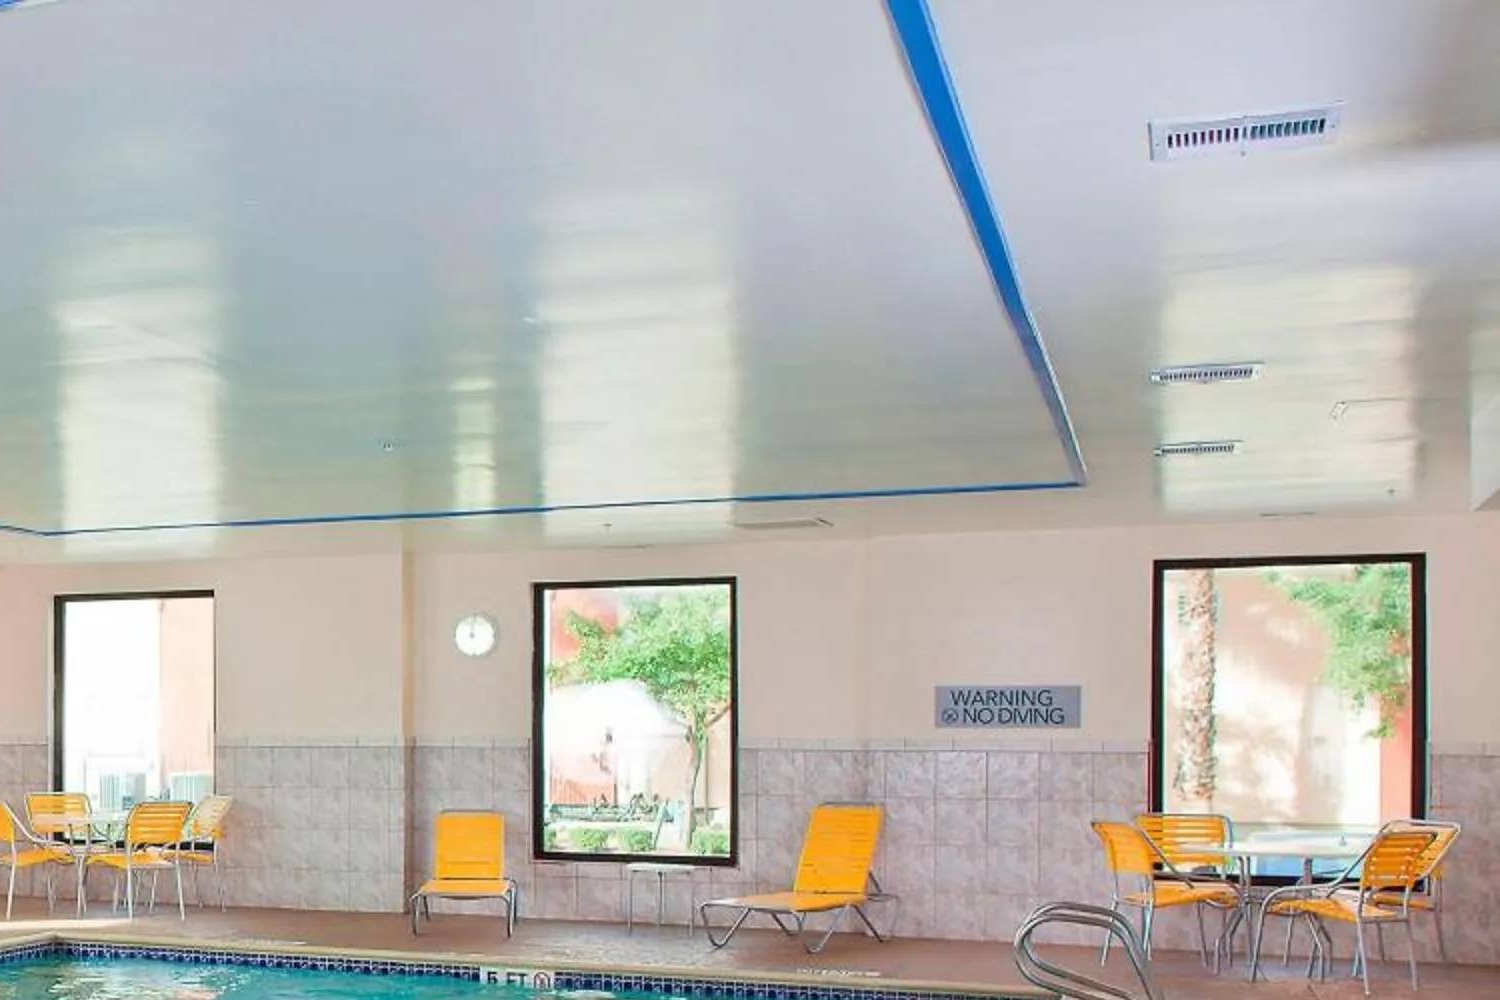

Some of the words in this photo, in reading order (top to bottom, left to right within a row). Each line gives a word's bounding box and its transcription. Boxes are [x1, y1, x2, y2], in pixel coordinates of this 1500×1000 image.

[950, 689, 1053, 706] WARNING
[963, 707, 995, 725] NO
[998, 707, 1066, 725] DIVING
[506, 972, 528, 985] FT
